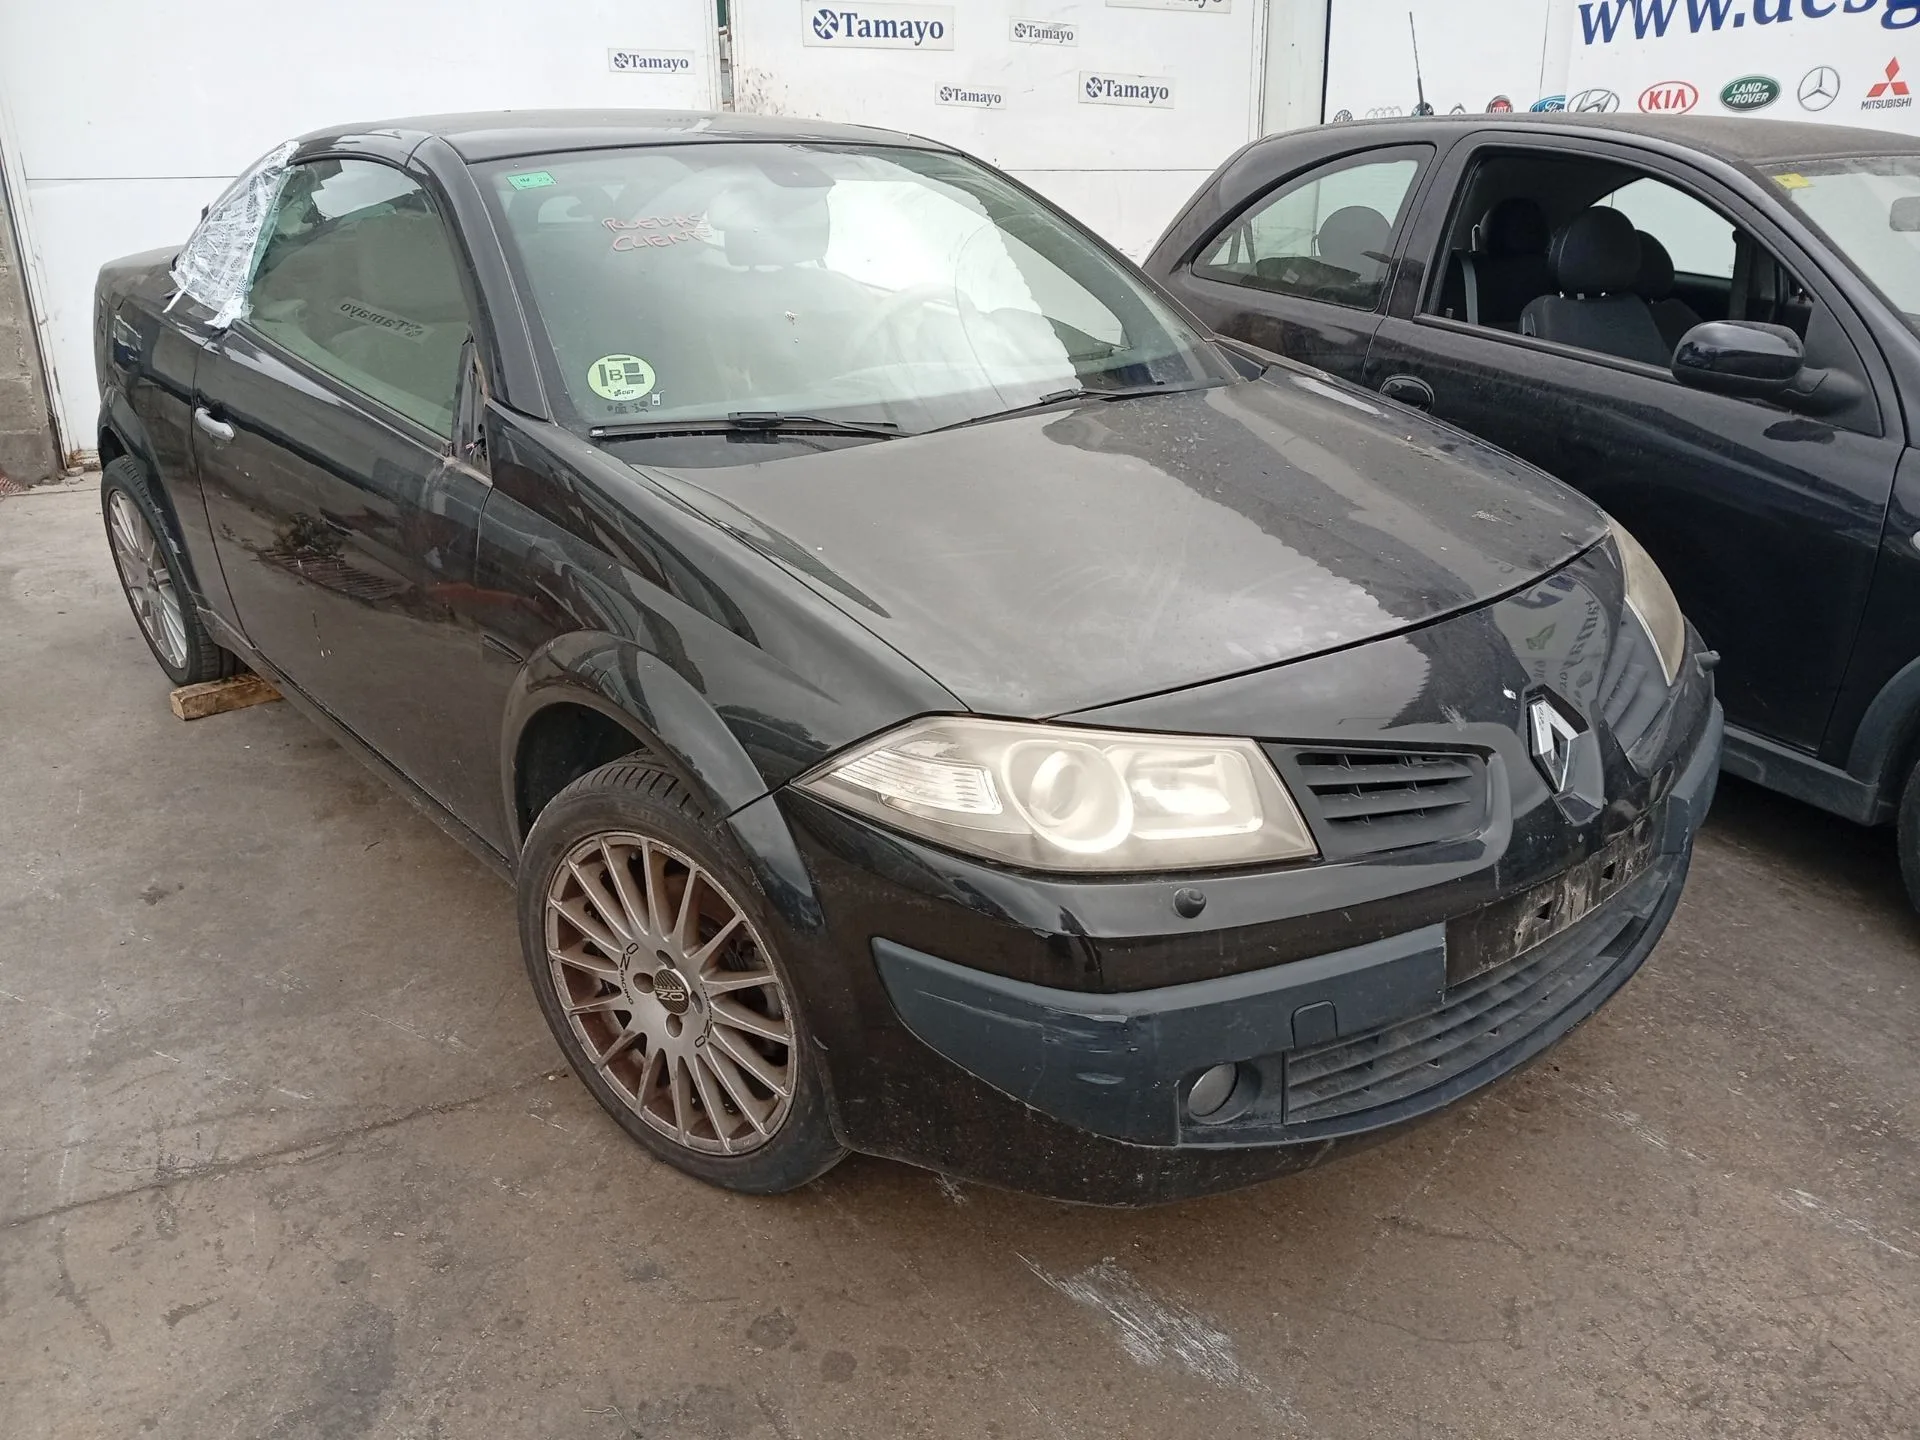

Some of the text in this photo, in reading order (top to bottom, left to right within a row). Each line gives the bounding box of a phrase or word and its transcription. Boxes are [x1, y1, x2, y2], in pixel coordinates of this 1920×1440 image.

[840, 12, 944, 46] Tamayo
[1027, 25, 1074, 44] Tamayo
[629, 54, 689, 72] Tamayo
[952, 88, 1001, 106] Tamayo
[1103, 79, 1169, 104] Tamayo
[1731, 82, 1762, 94] LAND
[1647, 88, 1687, 110] KIA
[1732, 92, 1770, 105] ROVER
[1861, 98, 1912, 110] MITSUBISHI
[608, 369, 623, 381] B
